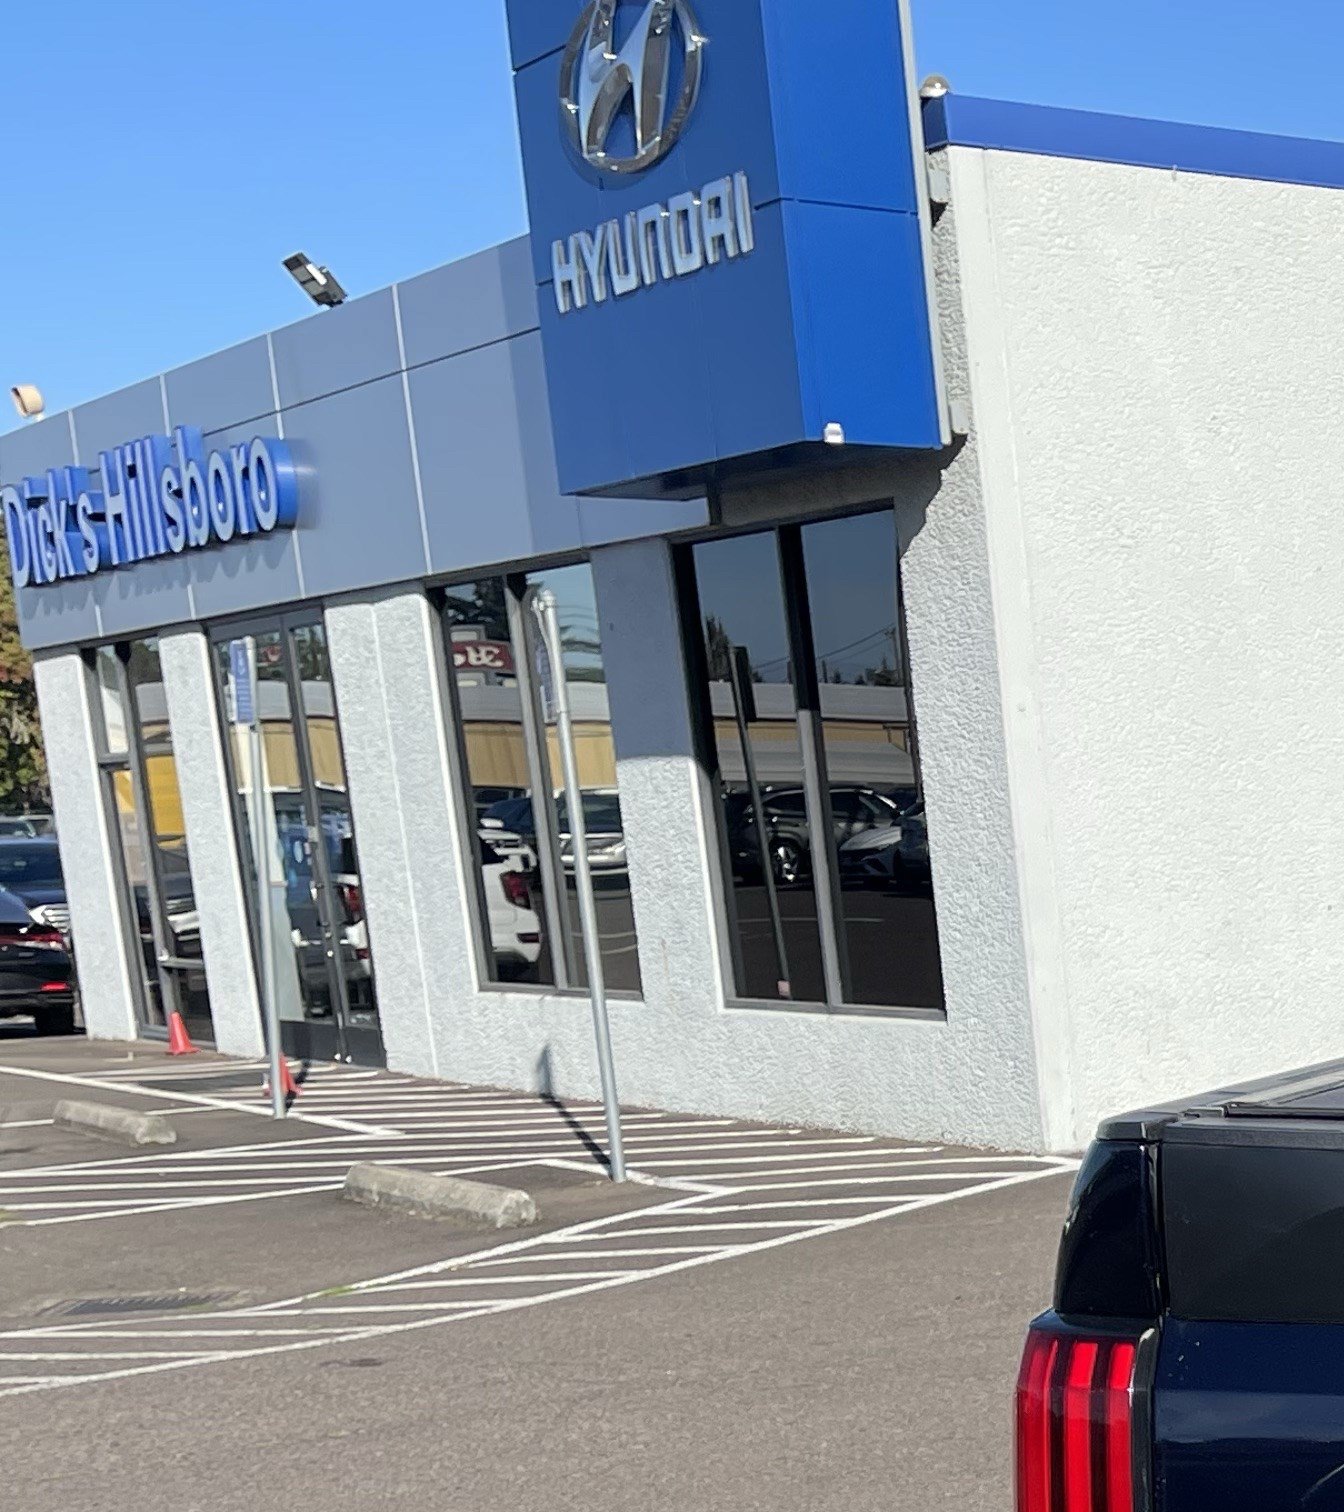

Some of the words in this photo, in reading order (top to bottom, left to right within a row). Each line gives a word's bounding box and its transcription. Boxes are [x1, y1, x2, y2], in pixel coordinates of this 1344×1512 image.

[551, 170, 754, 314] HYUNDAI
[1, 466, 99, 588] Dick's
[99, 425, 282, 566] Hillsboro
